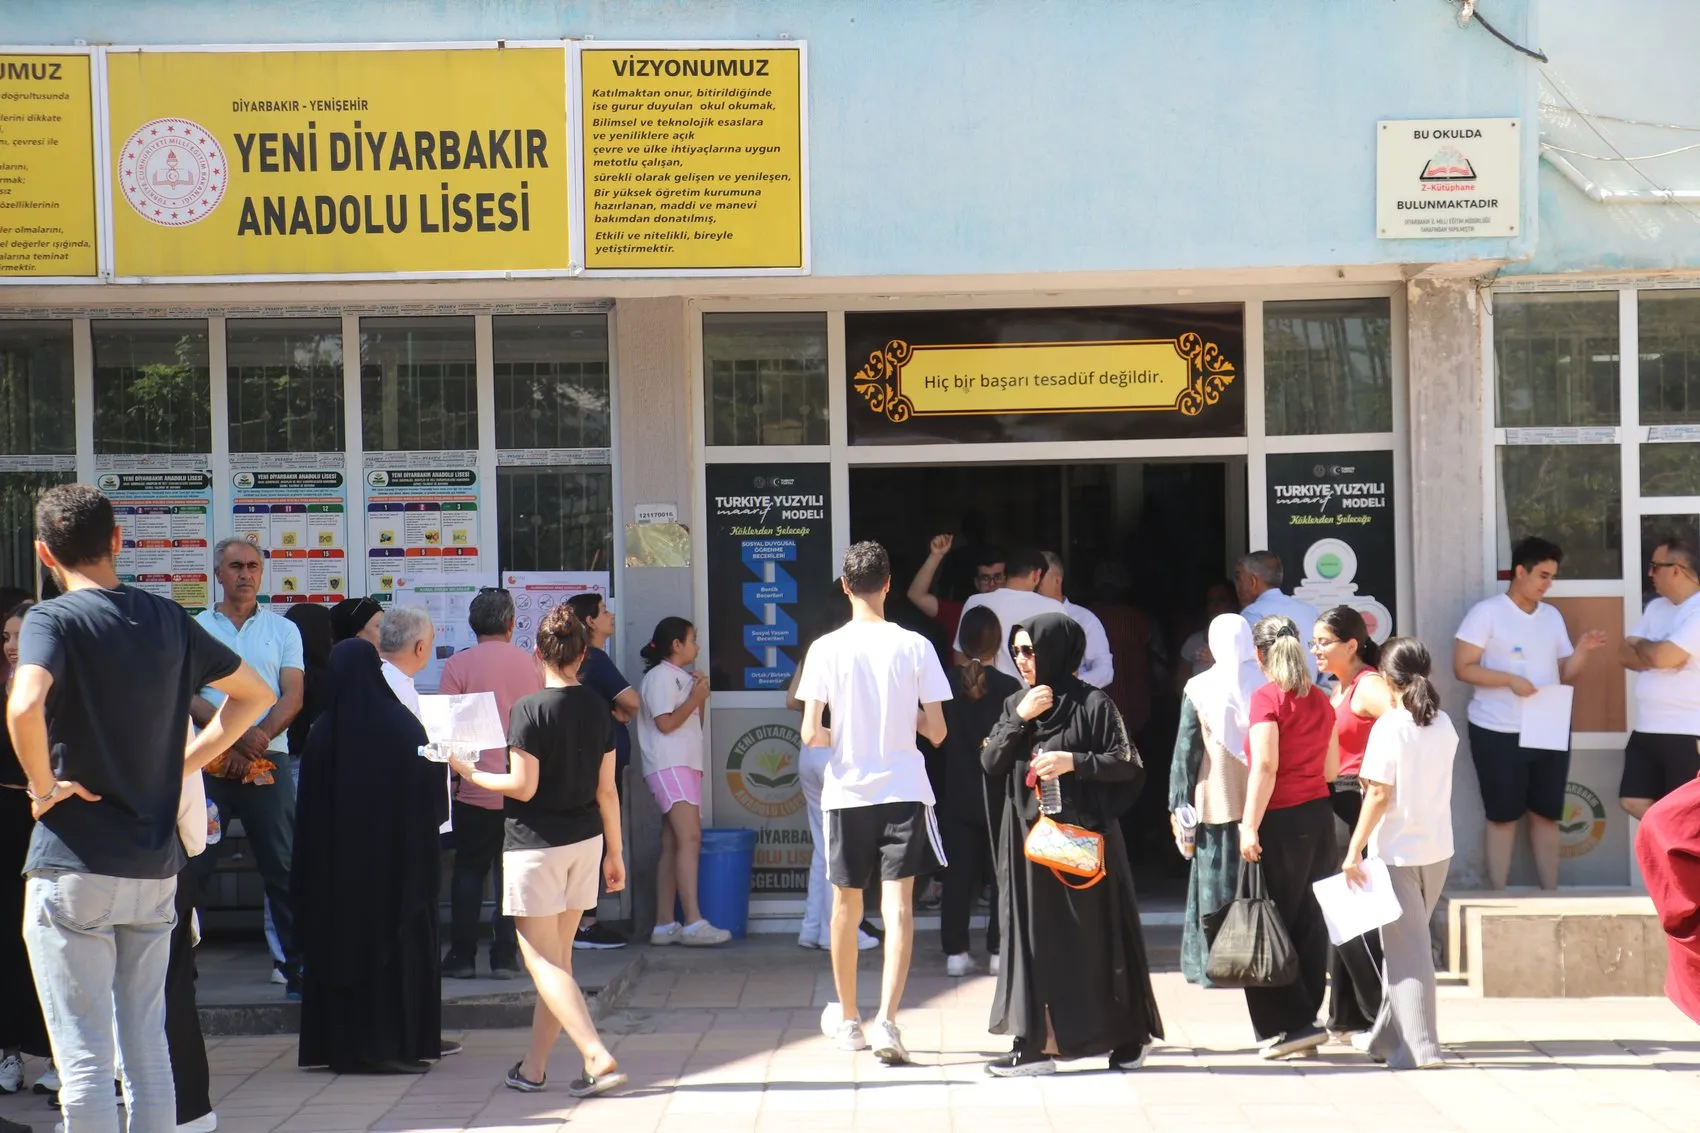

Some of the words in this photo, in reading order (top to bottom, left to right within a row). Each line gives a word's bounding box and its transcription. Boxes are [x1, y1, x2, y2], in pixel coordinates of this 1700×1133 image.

[612, 55, 769, 77] VİZYONUMUZ
[1, 92, 70, 101] doğrultusunda
[592, 88, 661, 98] Katılmaktan
[664, 90, 693, 98] onur,
[697, 88, 772, 99] bitirildiğinde
[232, 98, 300, 113] DİYARBAKIR
[309, 97, 369, 113] YENİŞEHİR
[592, 102, 608, 111] ise
[611, 103, 643, 112] gurur
[647, 102, 693, 112] duyulan
[700, 102, 725, 111] okul
[728, 101, 776, 112] okumak,
[0, 114, 25, 122] lerini
[27, 114, 62, 122] dikkate
[592, 118, 637, 127] Bilimsel
[657, 118, 714, 129] teknolojik
[717, 118, 764, 127] esaslara
[593, 132, 606, 140] ve
[609, 131, 670, 141] yeniliklere
[672, 131, 695, 141] açık
[1414, 130, 1430, 139] BU
[1432, 129, 1483, 139] OKULDA
[12, 138, 44, 147] çevresi
[233, 121, 318, 173] YENİ
[329, 120, 549, 172] DİYARBAKIR
[593, 146, 624, 155] çevre
[627, 146, 640, 154] ve
[643, 144, 668, 154] ülke
[671, 144, 741, 155] ihtiyaçlarına
[745, 146, 781, 155] uygun
[593, 158, 638, 167] metotlu
[641, 158, 683, 169] çalışan,
[0, 176, 26, 184] rmak;
[593, 173, 632, 182] sürekli
[635, 173, 671, 182] olarak
[674, 173, 715, 183] gelişen
[734, 172, 792, 183] yenileşen,
[594, 189, 610, 197] Bir
[613, 188, 652, 199] yüksek
[655, 188, 701, 199] öğretim
[704, 188, 762, 197] kurumuna
[1421, 183, 1476, 193] Z-Kütüphane
[237, 194, 408, 236] ANADOLU
[419, 180, 531, 234] LİSESİ
[594, 201, 657, 211] hazırlanan,
[660, 201, 696, 210] maddi
[699, 202, 713, 210] ve
[715, 201, 758, 210] manevi
[1397, 199, 1498, 210] BULUNMAKTADIR
[594, 215, 650, 223] bakımdan
[653, 214, 717, 225] donatılmış,
[15, 226, 64, 234] olmalarını,
[595, 232, 624, 240] Etkili
[627, 232, 641, 240] ve
[644, 231, 690, 241] nitelikli,
[694, 231, 734, 242] bireyle
[11, 240, 50, 249] değerler
[52, 240, 91, 249] ışığında,
[595, 244, 675, 255] yetiştirmektir.
[924, 375, 950, 392] Hiç
[953, 374, 976, 388] bir
[980, 373, 1029, 391] başarı
[1034, 371, 1095, 386] tesadüf
[1099, 370, 1164, 388] değildir.
[1342, 498, 1386, 508] MODELİ
[782, 509, 824, 519] MODELİ
[1289, 515, 1334, 525] Köklerden
[1336, 514, 1372, 525] Geleceğe
[729, 526, 773, 536] Köklerden
[775, 526, 810, 537] Geleceğe
